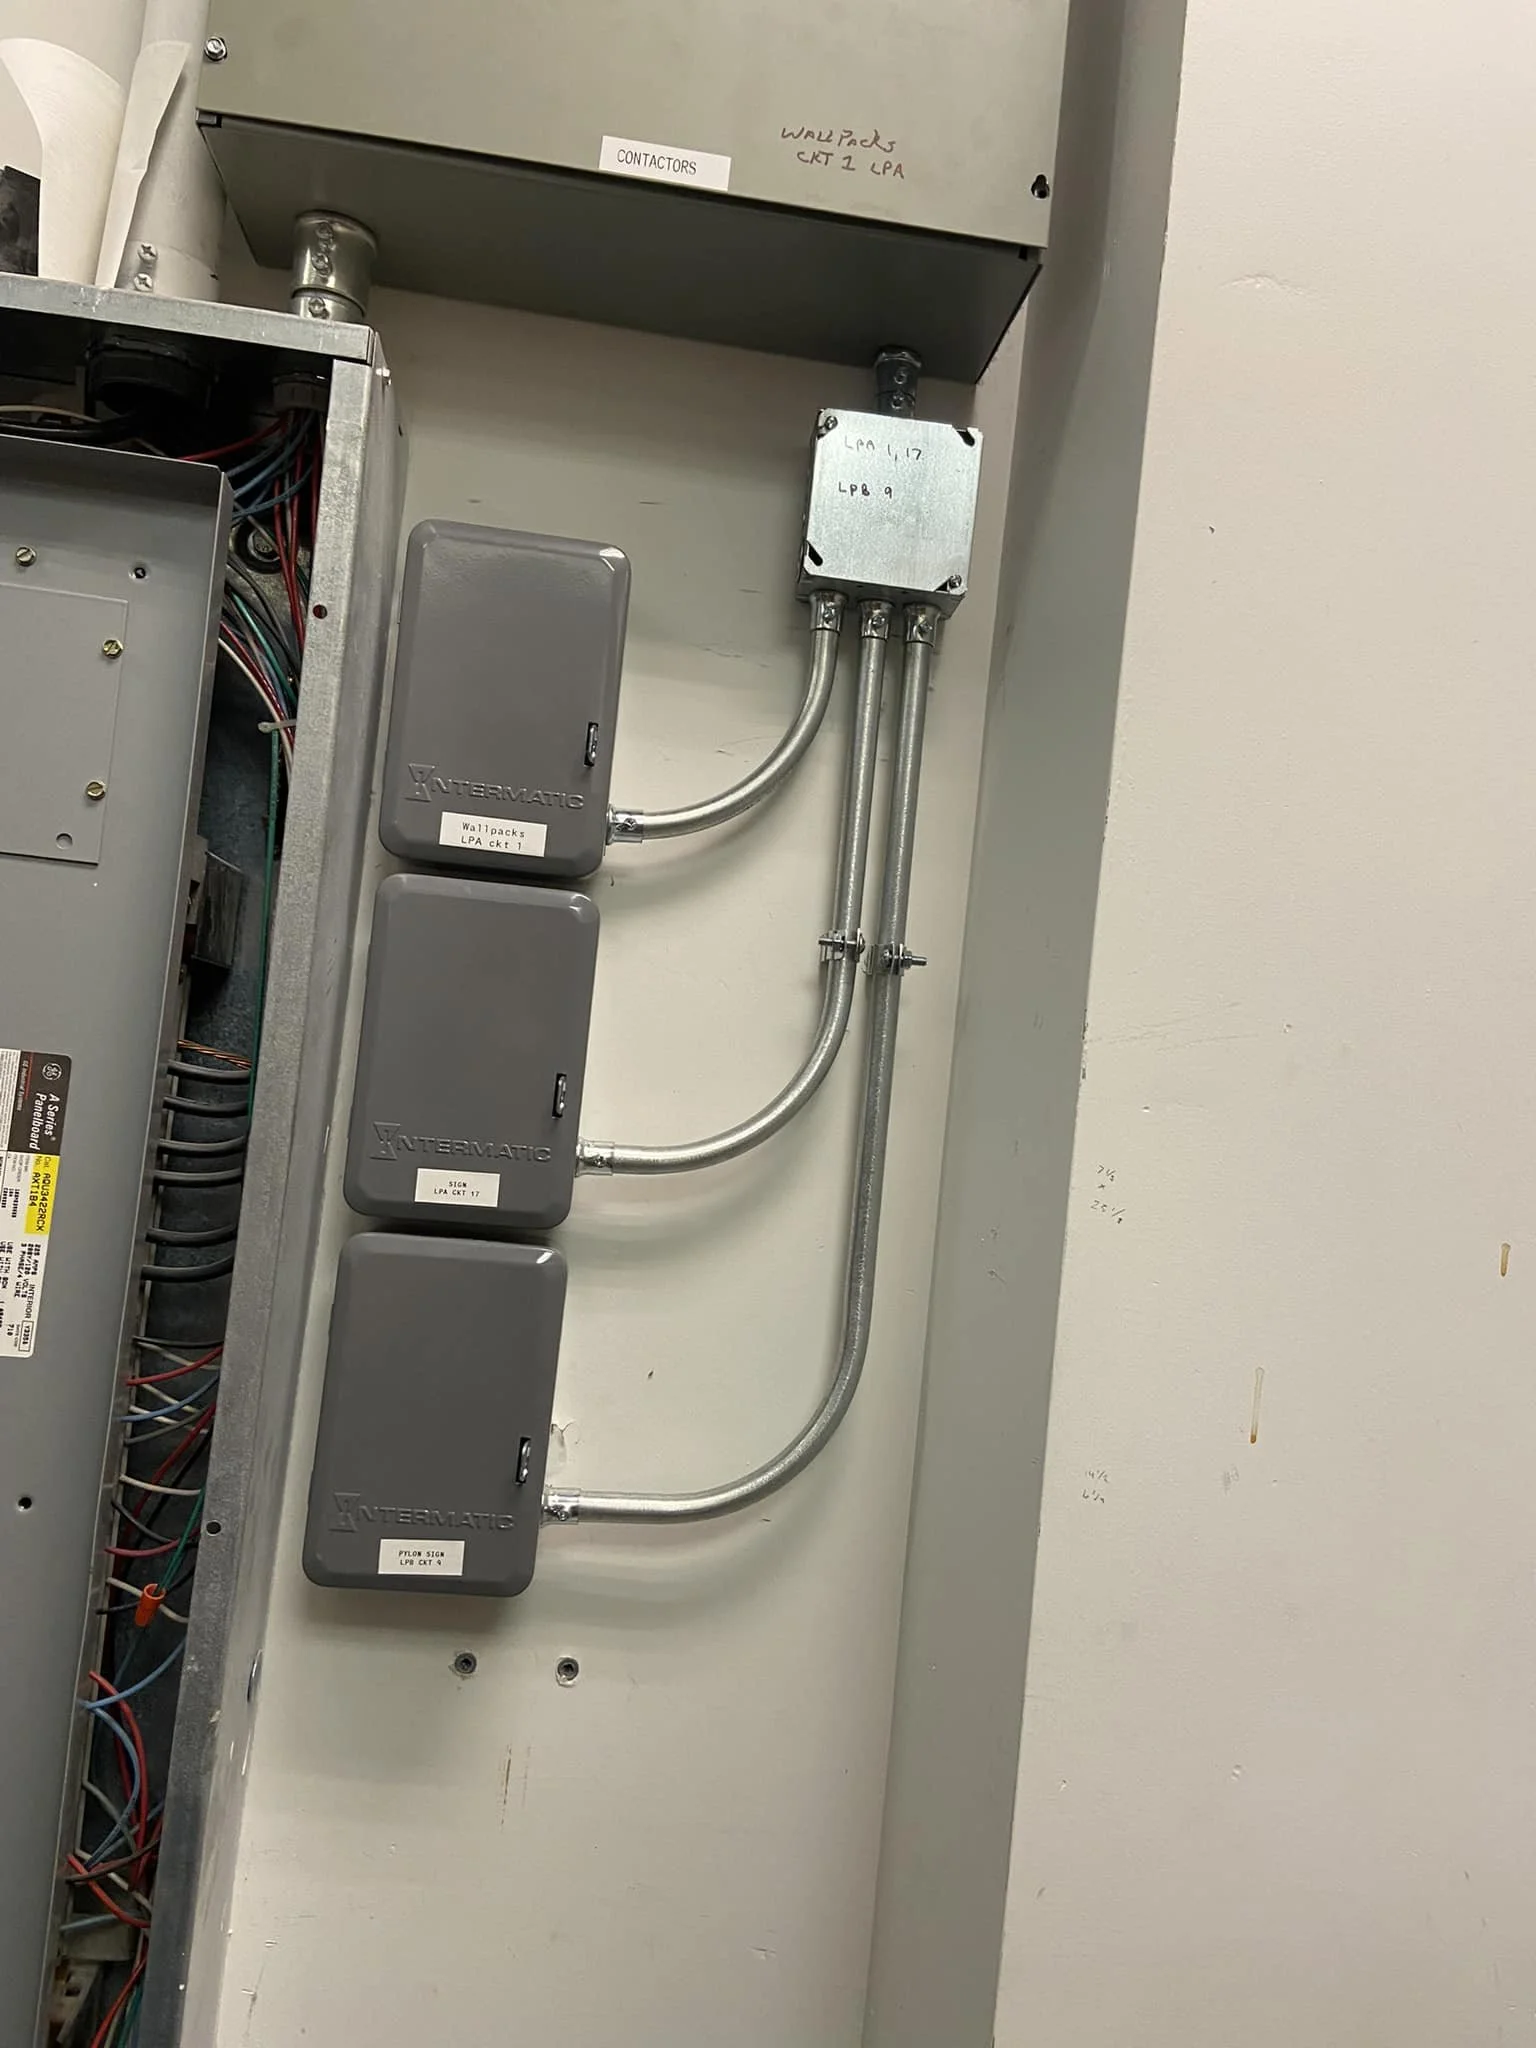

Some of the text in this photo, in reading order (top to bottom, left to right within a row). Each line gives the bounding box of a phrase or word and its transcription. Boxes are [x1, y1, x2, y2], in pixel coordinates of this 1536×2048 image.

[616, 148, 697, 176] CONTACTORS
[796, 150, 835, 167] CKT
[869, 161, 905, 180] LPA
[838, 480, 894, 500] LPB 9
[461, 835, 483, 846] LPA
[488, 839, 510, 849] ckt
[462, 822, 526, 839] Wallpacks
[29, 1093, 47, 1150] Panelboard
[44, 1093, 61, 1137] A Series
[433, 1187, 480, 1198] LPA CKT 17
[448, 1180, 467, 1188] SIGN
[24, 1284, 36, 1319] INTERIOR
